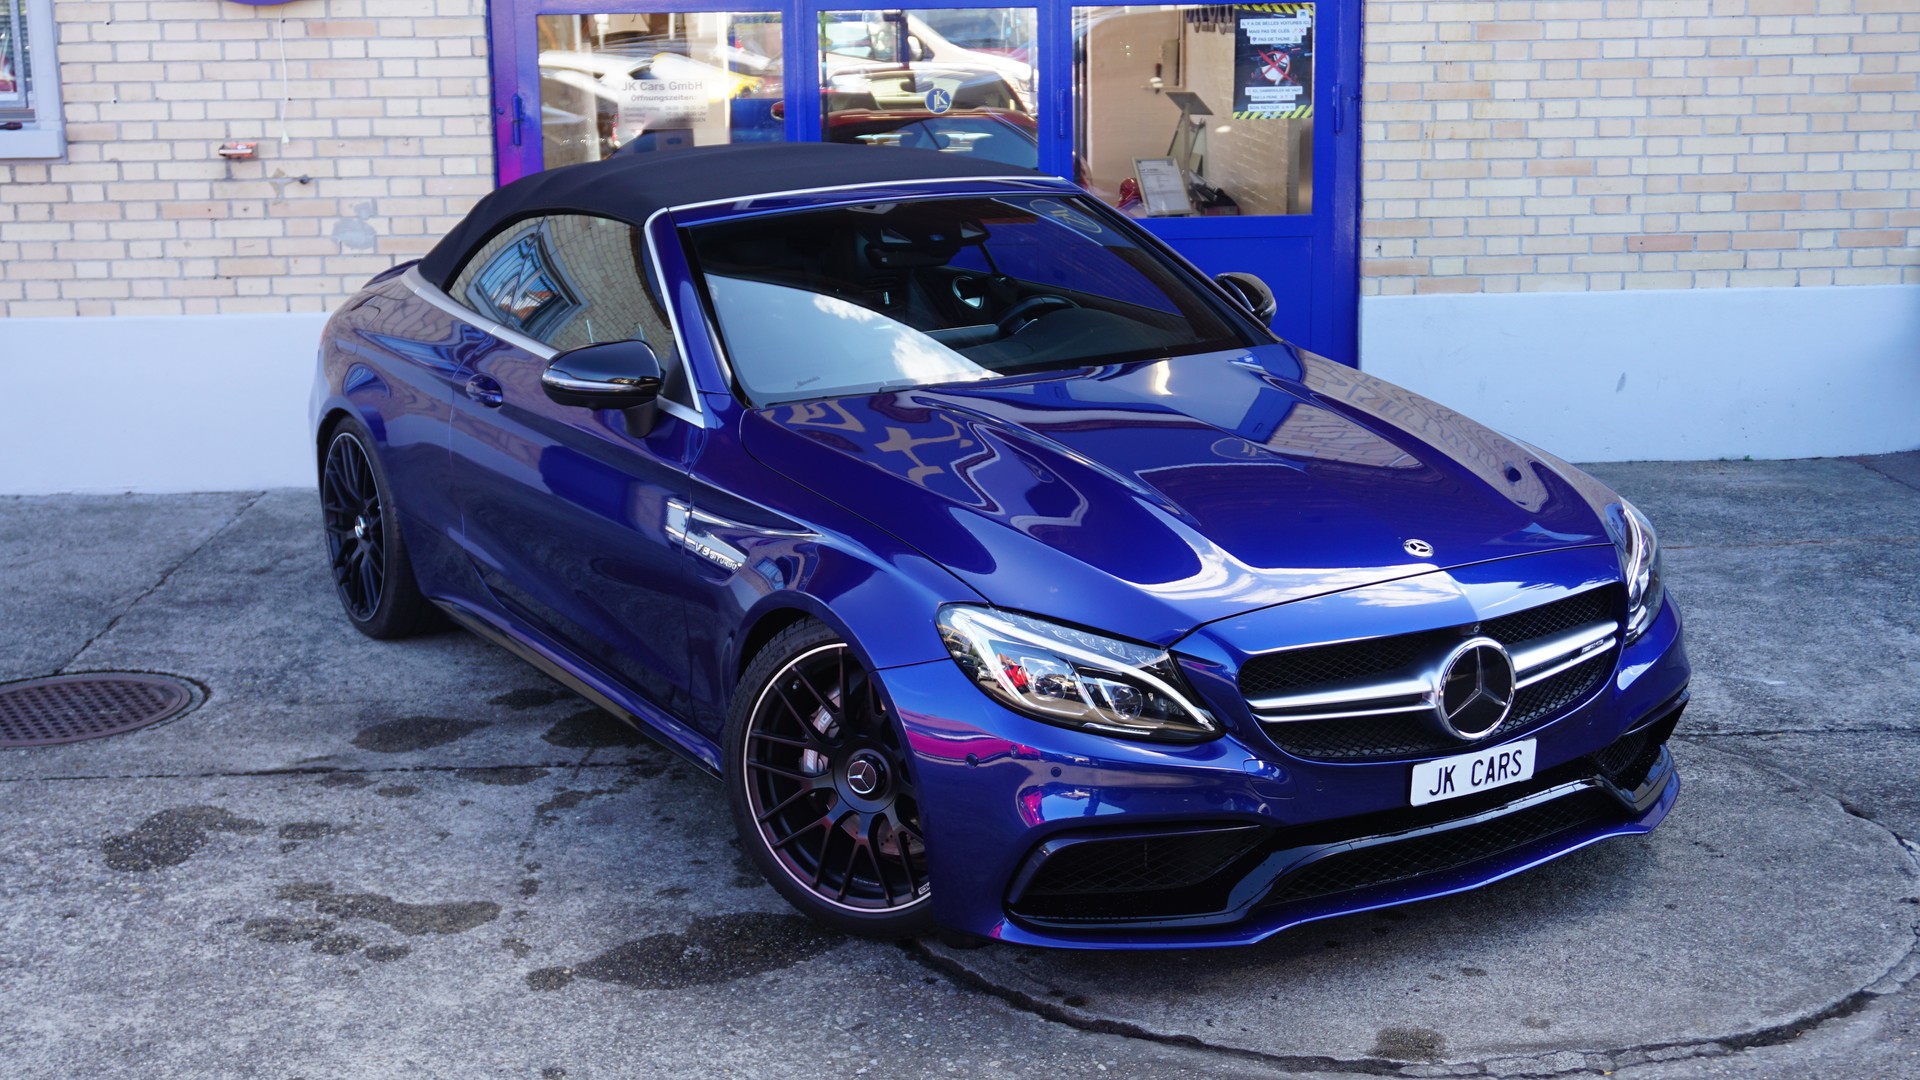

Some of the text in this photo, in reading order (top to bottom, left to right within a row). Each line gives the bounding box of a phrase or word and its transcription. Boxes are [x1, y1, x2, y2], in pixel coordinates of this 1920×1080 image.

[622, 81, 703, 91] JK Cars GmbH
[710, 553, 738, 570] BITURBO
[1429, 749, 1522, 796] JK CARS
